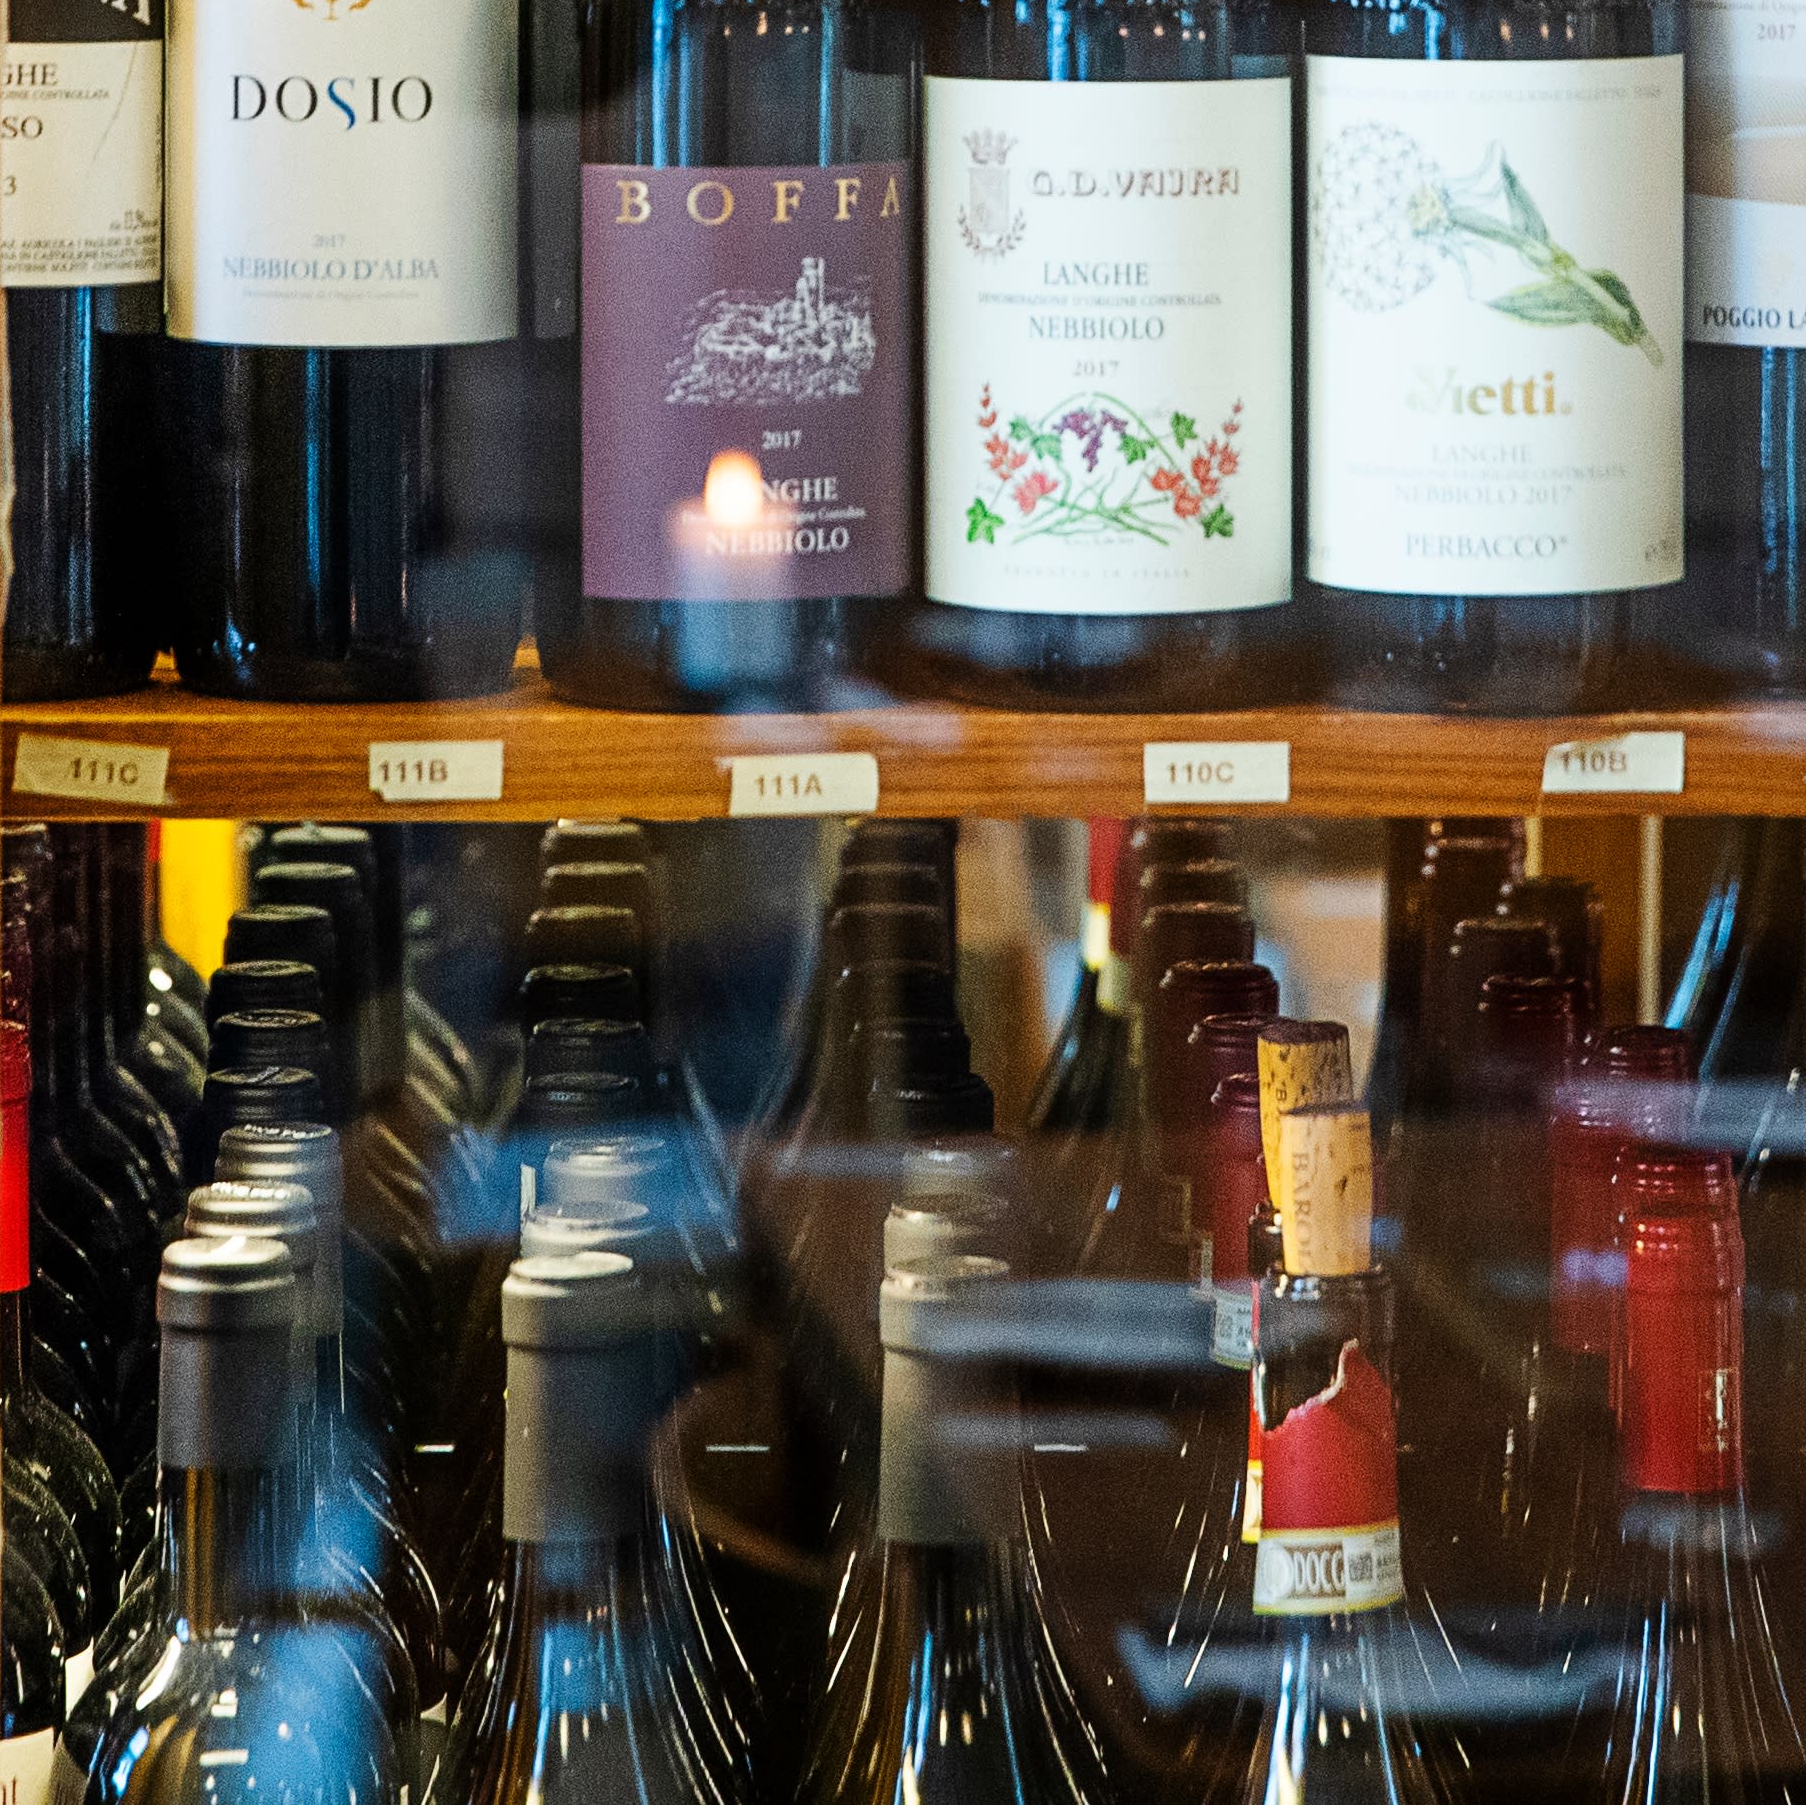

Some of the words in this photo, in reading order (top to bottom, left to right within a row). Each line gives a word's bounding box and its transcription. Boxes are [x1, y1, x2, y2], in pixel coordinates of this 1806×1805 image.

[1756, 23, 1797, 42] 2017
[230, 74, 434, 131] DOSIO
[223, 257, 346, 281] NEBBIOLO
[353, 258, 440, 281] D'ALBA
[1043, 261, 1150, 288] LANGHE
[1028, 314, 1166, 342] NEBBIOLO
[1702, 306, 1783, 331] POGGIO
[1071, 358, 1121, 378] 2017
[762, 429, 803, 450] 2017
[760, 476, 839, 504] NGHE
[68, 756, 140, 786] 111C
[377, 758, 449, 785] 111B
[1164, 761, 1236, 786] 110C
[1558, 747, 1628, 777] 110B
[754, 772, 824, 799] 111A
